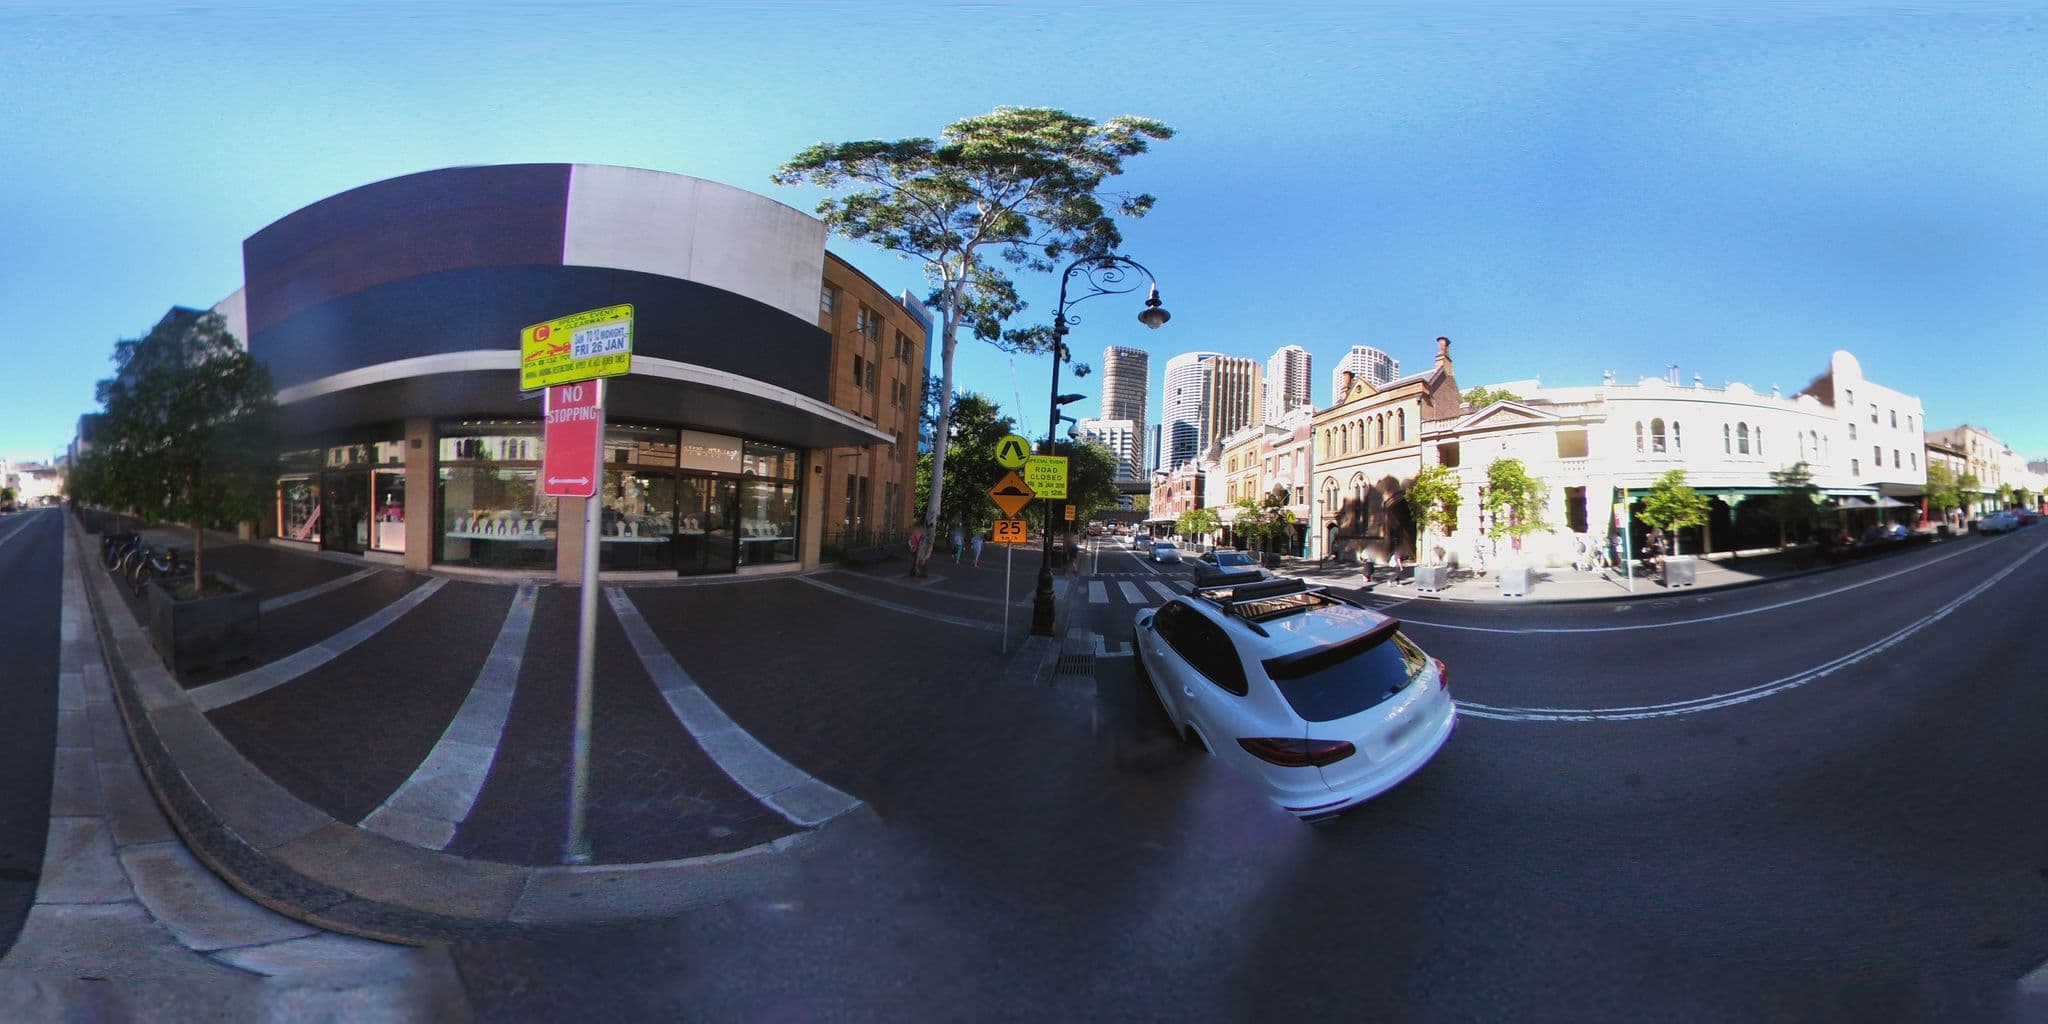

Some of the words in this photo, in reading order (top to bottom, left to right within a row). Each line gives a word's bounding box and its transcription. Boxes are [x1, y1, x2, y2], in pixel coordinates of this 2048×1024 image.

[589, 309, 615, 319] EVENT
[565, 317, 606, 330] CLEARWAY
[575, 344, 589, 357] FRI
[592, 341, 603, 353] 26
[605, 338, 624, 351] JAN
[562, 385, 583, 403] NO
[548, 405, 597, 424] STOPPING
[1035, 466, 1058, 474] ROAD
[1030, 473, 1062, 481] CLOSED
[999, 522, 1020, 535] 25
